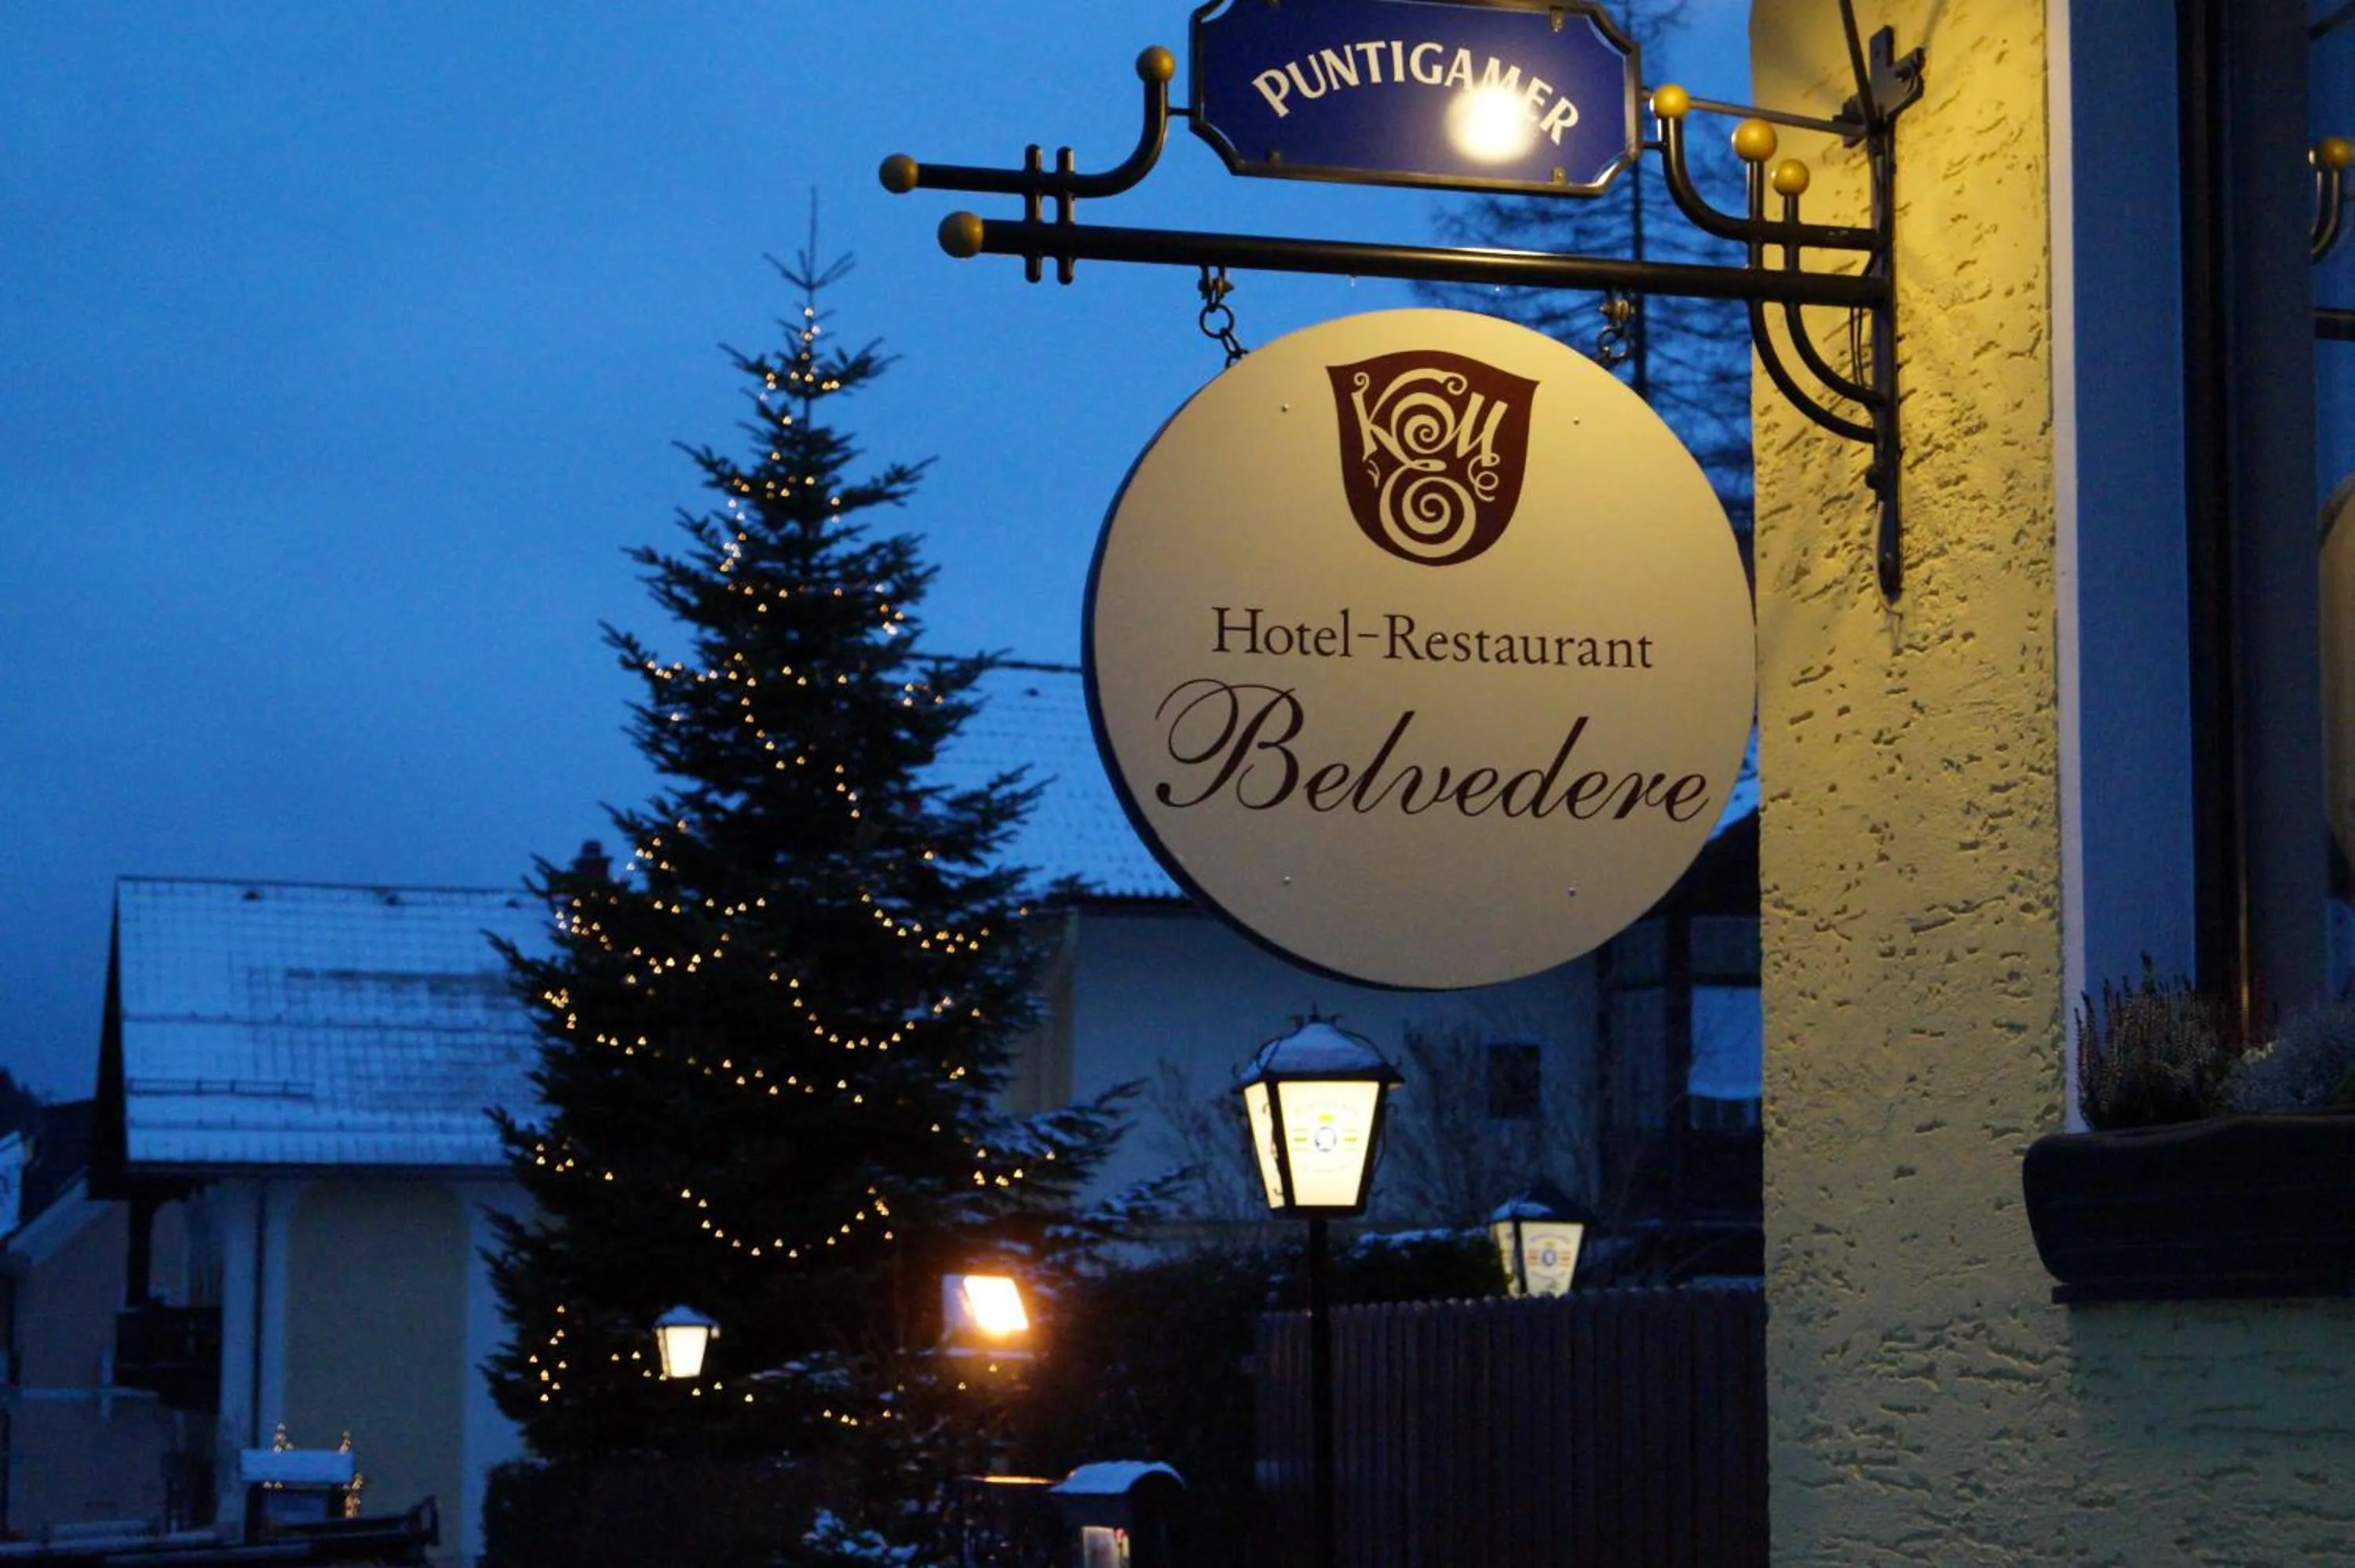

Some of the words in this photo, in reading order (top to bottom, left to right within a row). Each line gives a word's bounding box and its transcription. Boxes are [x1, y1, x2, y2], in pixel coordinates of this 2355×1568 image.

[1252, 40, 1579, 147] PUNTIGAMER
[1211, 607, 1652, 669] Hotel-Restaurant
[1155, 678, 1710, 822] Belvedere
